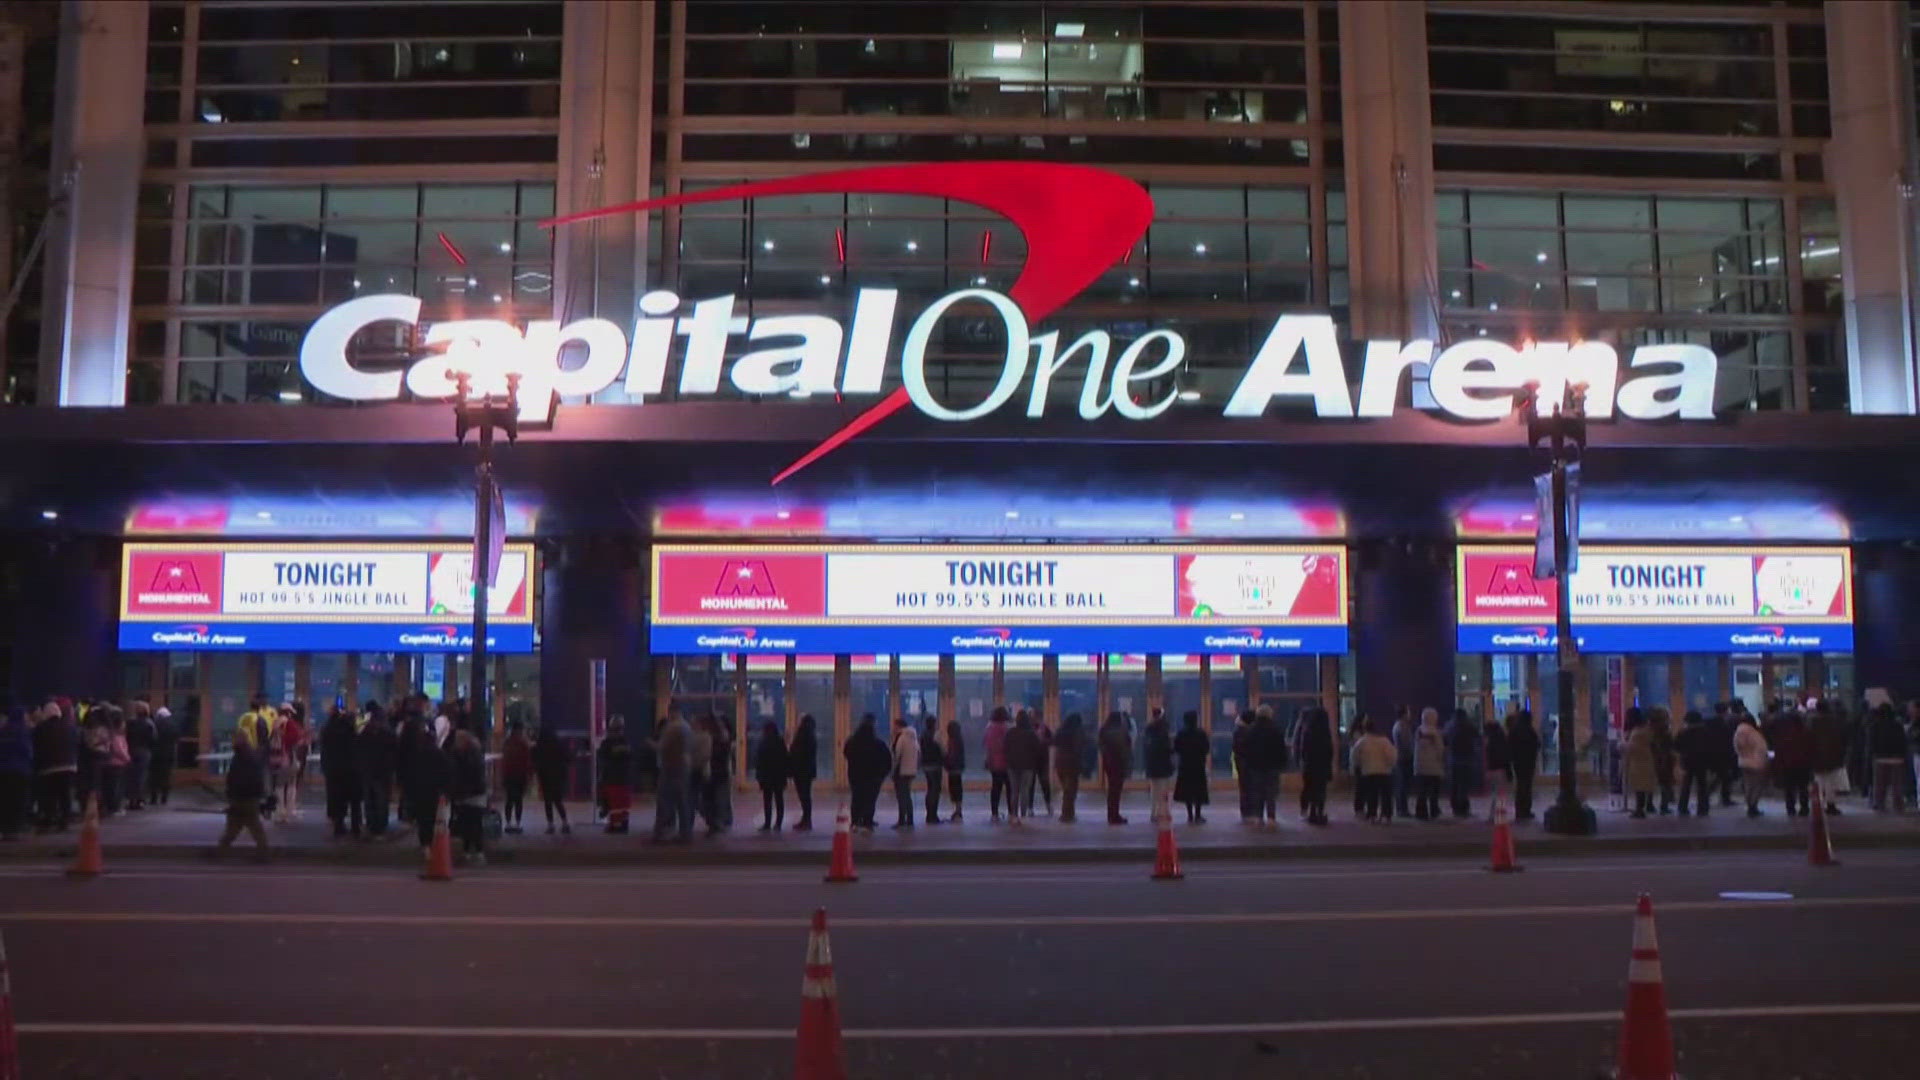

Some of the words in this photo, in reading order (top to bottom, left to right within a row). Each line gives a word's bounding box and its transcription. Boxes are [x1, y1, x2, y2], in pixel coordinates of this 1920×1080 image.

[1222, 314, 1718, 420] Arena
[273, 561, 377, 587] TONIGHT
[945, 560, 1058, 587] TONIGHT
[1607, 564, 1706, 588] TONIGHT
[138, 592, 211, 605] MONUMENTAL
[239, 591, 265, 605] HOT
[322, 591, 367, 605] JINGLE
[375, 591, 409, 606] BALL
[700, 597, 788, 610] MONUMENTAL
[895, 592, 928, 608] HOT
[935, 592, 991, 608] 99.5'S
[998, 592, 1058, 608] JINGLE
[1065, 592, 1106, 608] BALL
[1475, 594, 1548, 607] MONUMENTAL
[1575, 594, 1600, 606] HOT
[1656, 594, 1699, 606] JINGLE
[211, 633, 247, 645] Arena
[759, 637, 797, 648] Arena
[1014, 637, 1051, 649] Arena
[1265, 637, 1302, 649] Arena
[1787, 635, 1821, 647] Arena
